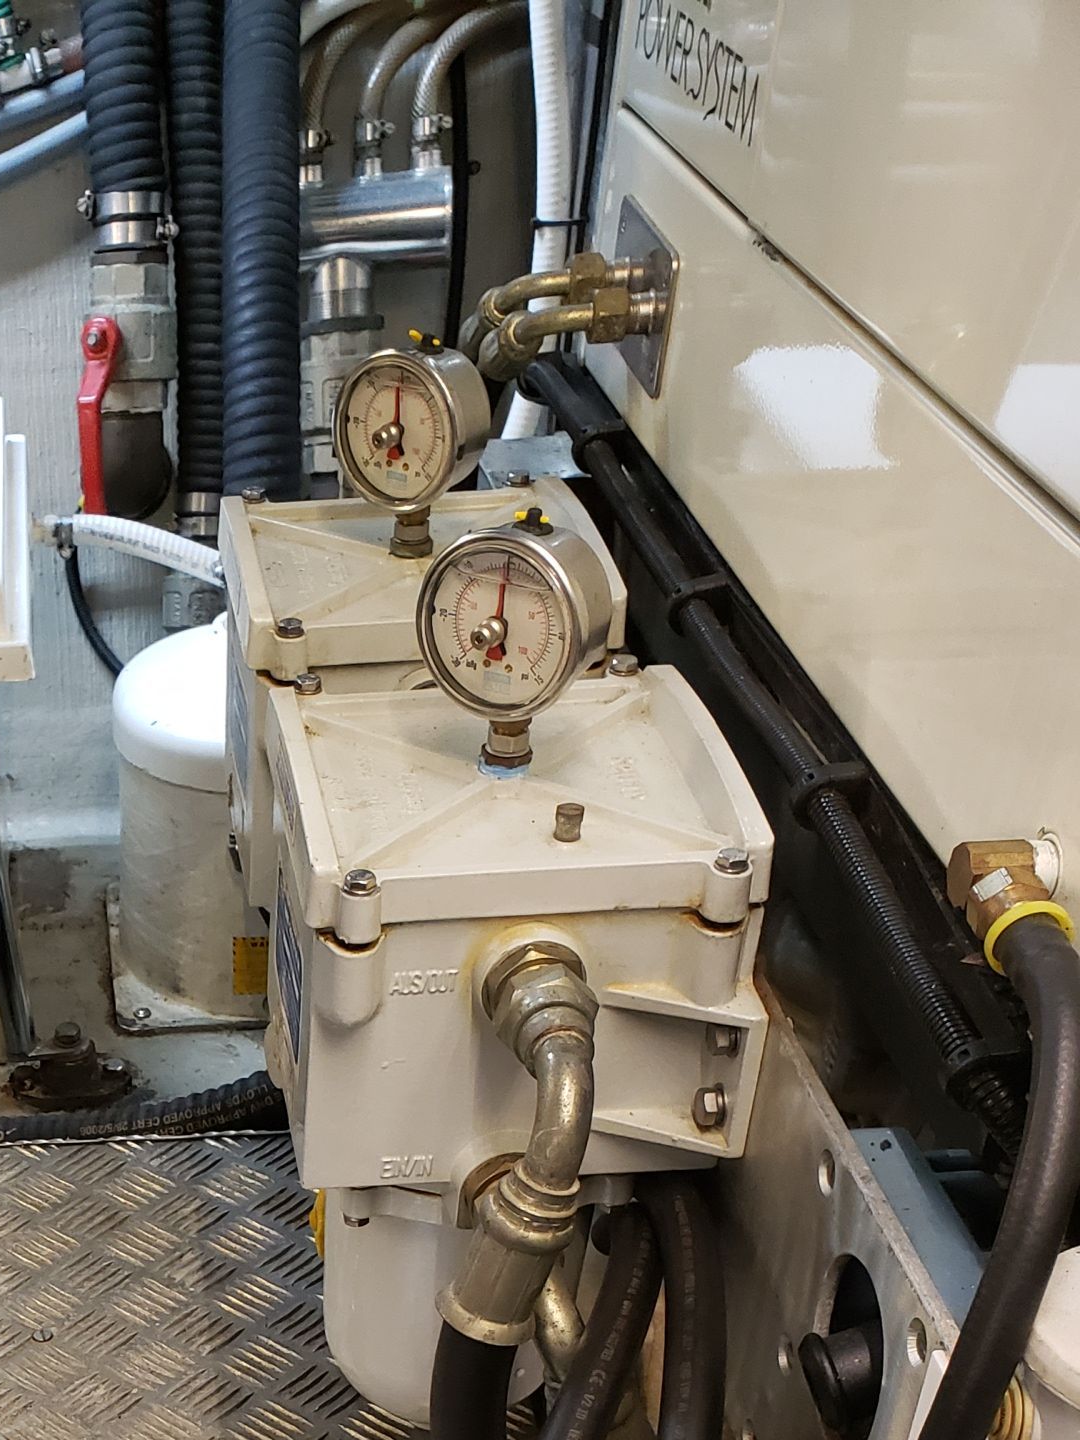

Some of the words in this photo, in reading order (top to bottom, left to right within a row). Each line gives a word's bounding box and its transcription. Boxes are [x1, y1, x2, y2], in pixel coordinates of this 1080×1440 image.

[635, 0, 695, 92] POWER
[686, 27, 760, 147] SYSTEM
[389, 969, 459, 996] AUS/OUT
[229, 1084, 269, 1108] LLOYDS
[131, 1116, 160, 1130] CERT
[163, 1104, 222, 1125] APPROVED
